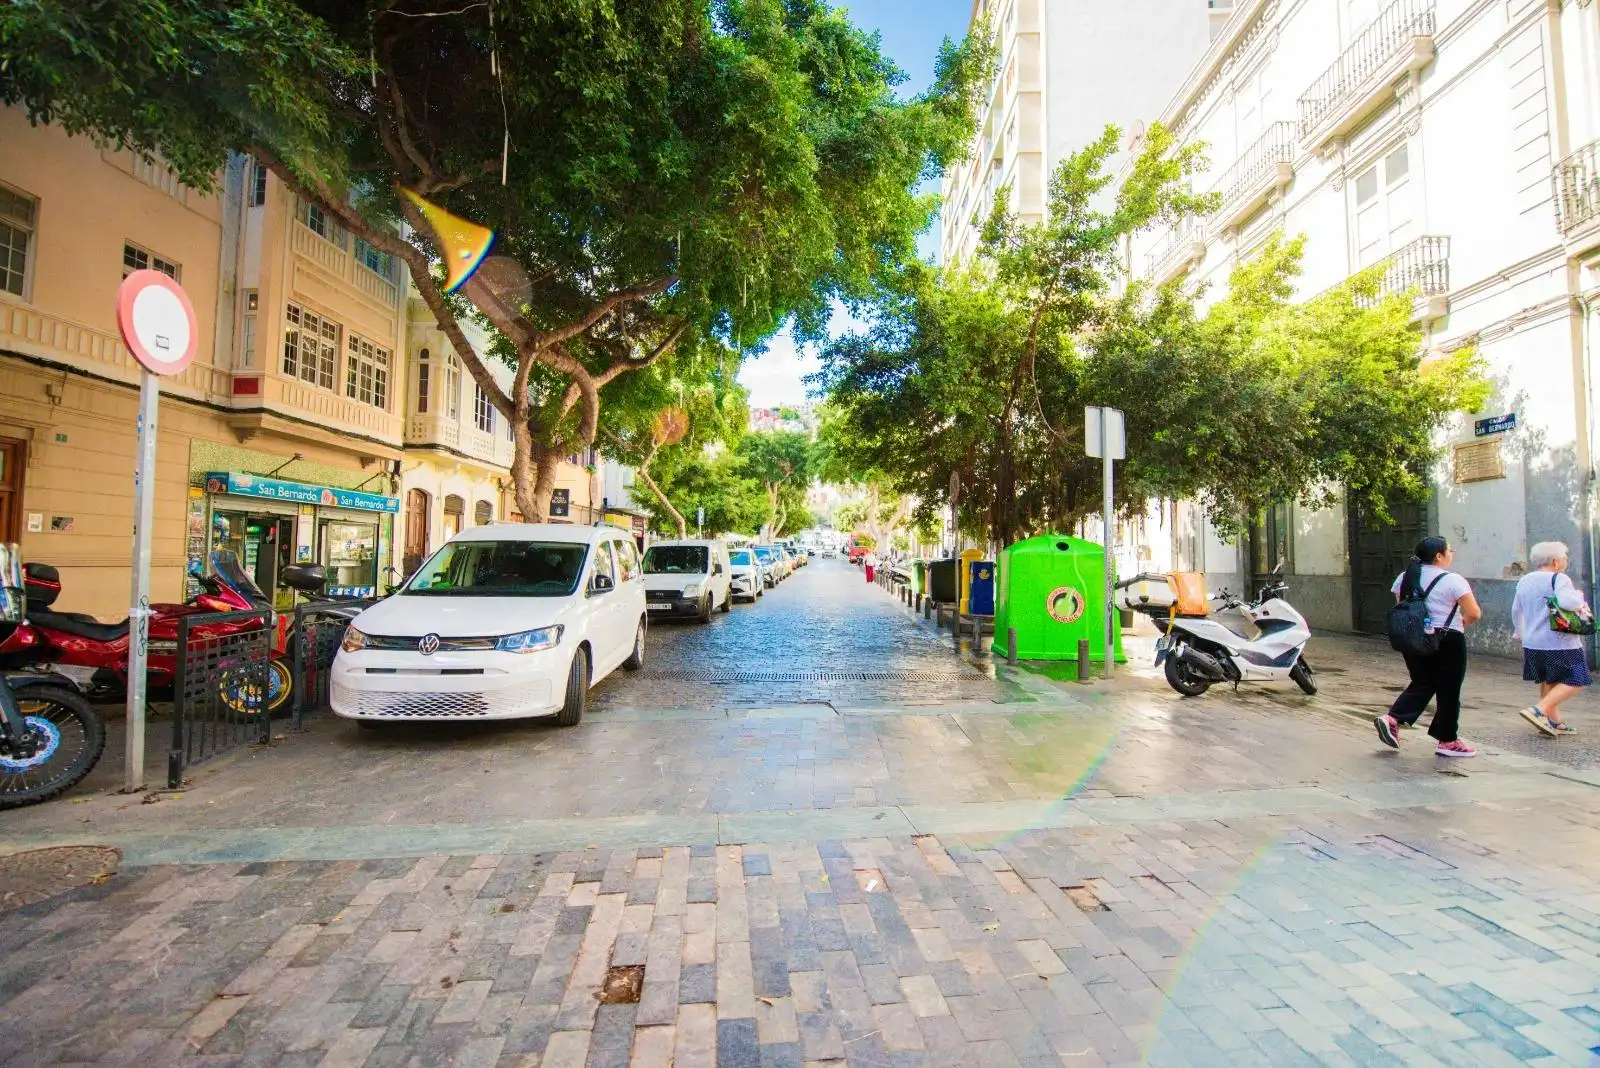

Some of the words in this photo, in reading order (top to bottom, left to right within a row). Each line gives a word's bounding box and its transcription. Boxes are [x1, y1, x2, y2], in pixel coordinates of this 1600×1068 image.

[258, 483, 275, 496] San
[277, 486, 317, 501] Bernardo
[341, 495, 353, 505] San
[354, 497, 384, 509] Bernardo
